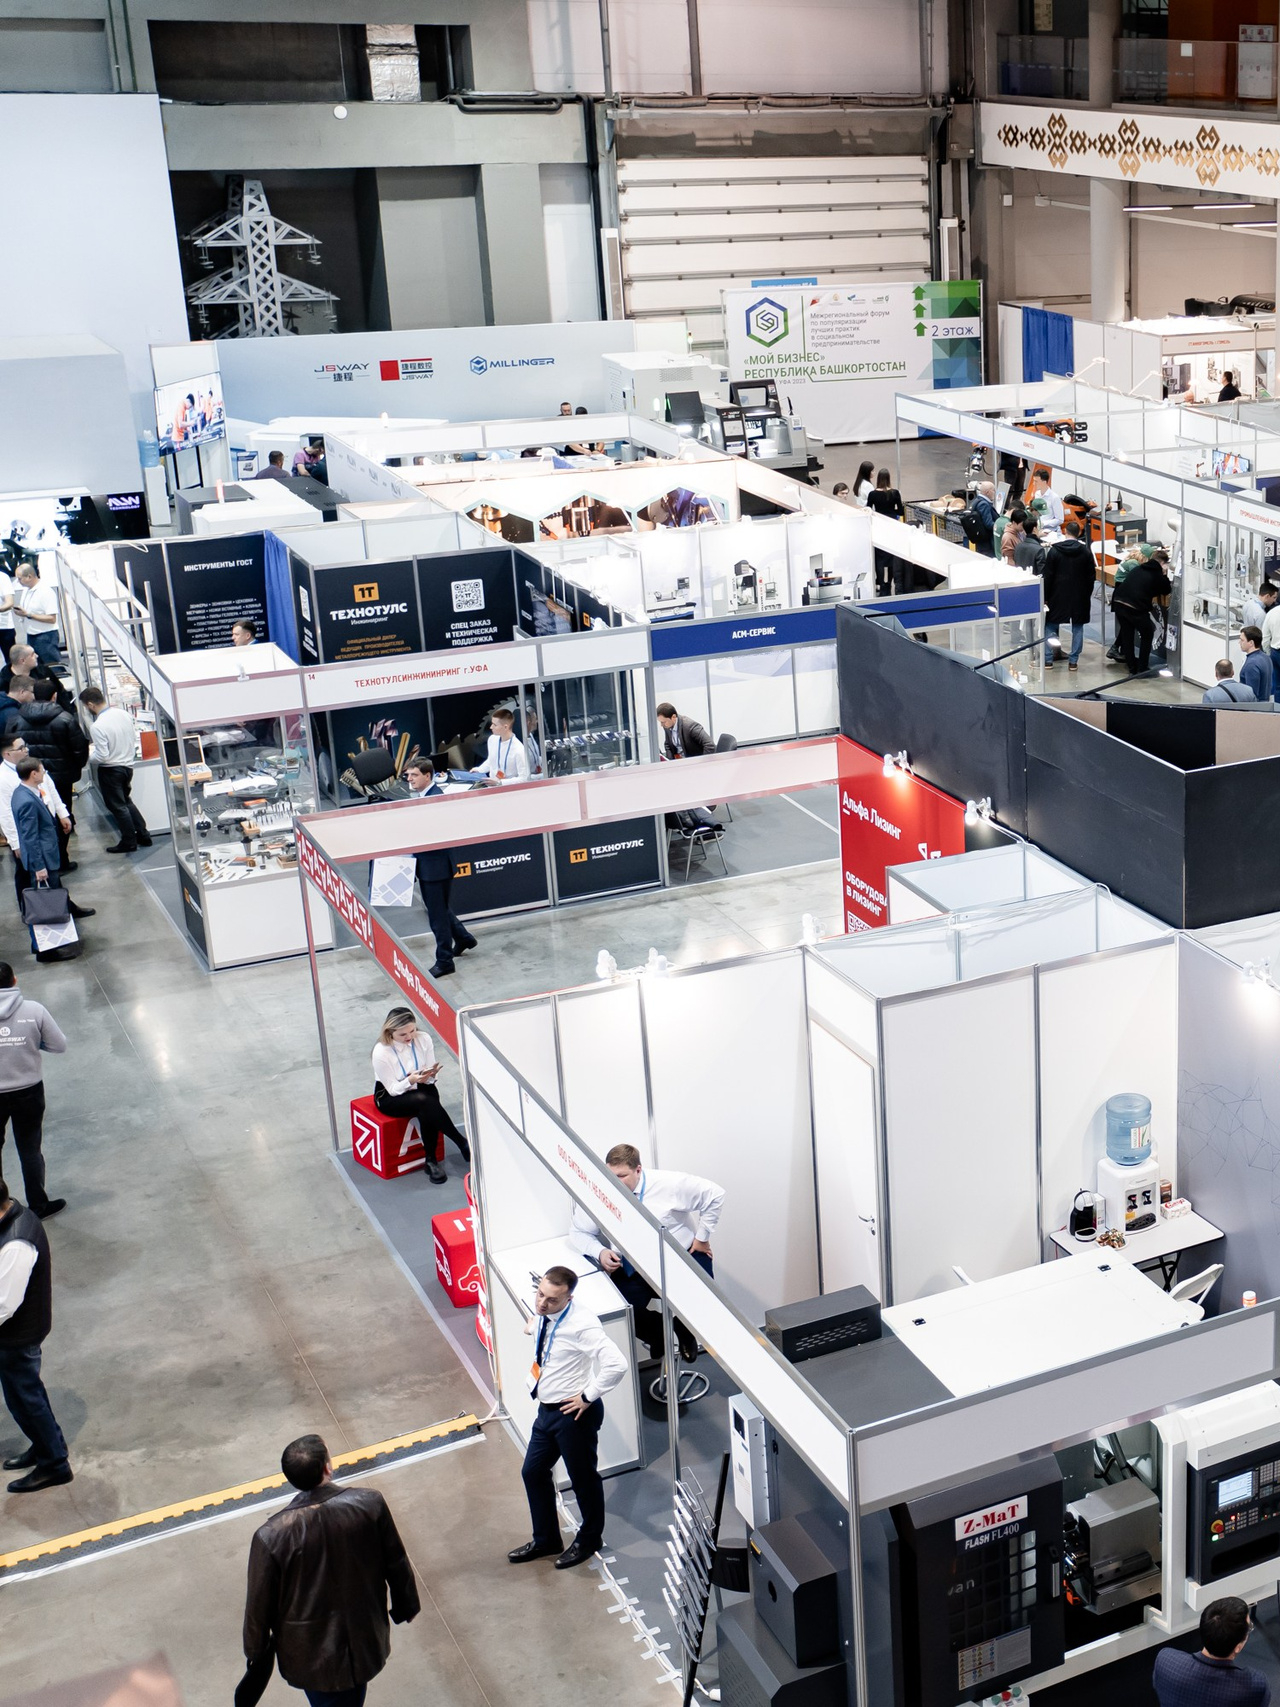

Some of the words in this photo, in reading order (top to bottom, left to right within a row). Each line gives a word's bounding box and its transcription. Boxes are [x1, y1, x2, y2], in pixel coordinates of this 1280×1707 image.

[810, 310, 869, 320] Межрегиональный
[870, 309, 890, 319] форум
[820, 318, 867, 327] популяризации
[816, 333, 854, 341] социальном
[834, 326, 860, 334] практик
[931, 325, 940, 338] 2
[942, 324, 974, 337] этаж
[811, 338, 880, 348] предпринимательстве
[489, 357, 556, 369] MILLINGER
[744, 352, 775, 365] «МОЙ
[777, 351, 826, 364] БИЗНЕС»
[314, 362, 370, 373] JSWAY
[401, 373, 434, 381] JSWAY
[333, 372, 355, 382] 捷程
[744, 365, 818, 380] РЕСПУБЛИКА
[819, 361, 907, 375] БАШКОРТОСТАН
[184, 560, 235, 572] ИНСТРУМЕНТЫ
[236, 558, 254, 567] ГОСТ
[329, 602, 408, 621] ТЕХНОТУЛС
[350, 616, 389, 627] Инжиниринг
[450, 621, 469, 630] СПЕЦ
[469, 619, 492, 628] ЗАКАЗ
[452, 626, 498, 638] ТЕХНИЧЕСКАЯ
[732, 626, 777, 639] АСМ-СЕРВИС
[452, 635, 494, 646] ПОДДЕРЖКА
[308, 673, 316, 681] 14
[463, 664, 489, 674] г.УФА
[843, 791, 869, 821] Альфа
[870, 808, 902, 841] Лизинг
[590, 839, 645, 855] ТЕХНОТУЛС
[474, 853, 532, 869] ТЕХНОТУЛС
[846, 884, 852, 897] В
[852, 890, 882, 917] ЛИЗИНГ
[393, 950, 415, 989] Альфа
[414, 975, 440, 1017] Лизинг
[963, 1504, 1020, 1535] Z-MaT
[964, 1532, 990, 1550] FLASH
[991, 1522, 1020, 1541] FL400
